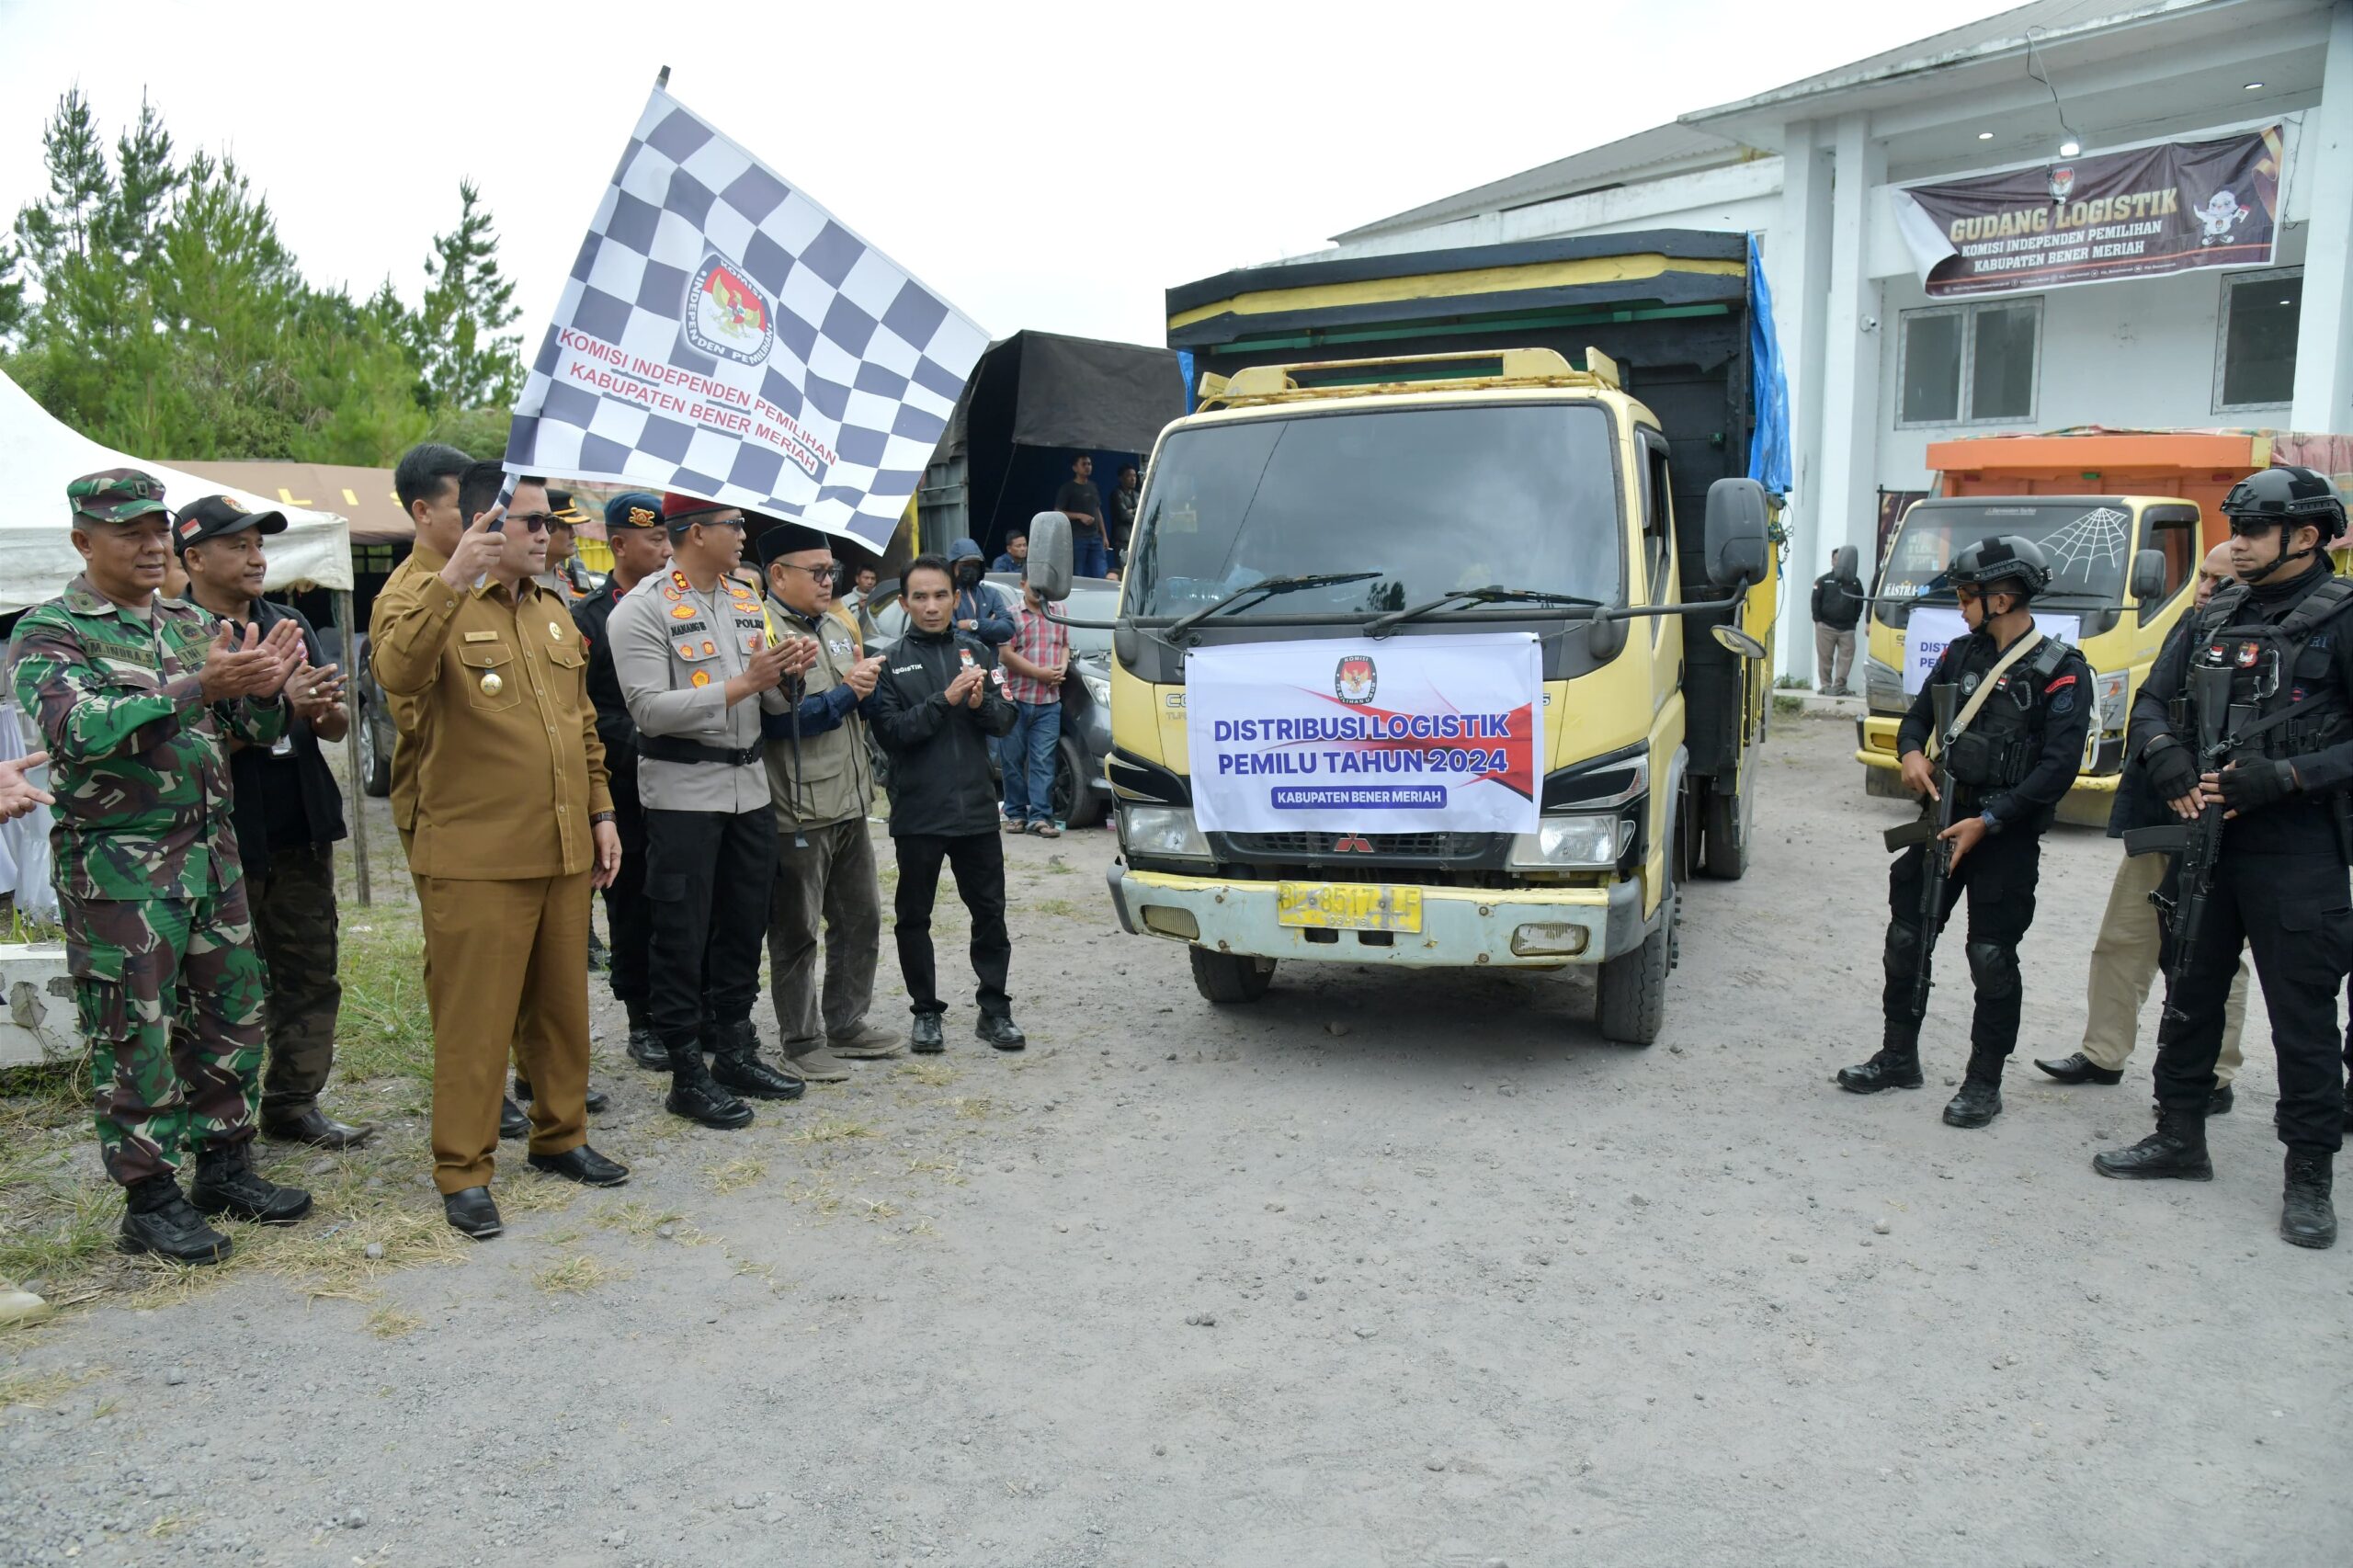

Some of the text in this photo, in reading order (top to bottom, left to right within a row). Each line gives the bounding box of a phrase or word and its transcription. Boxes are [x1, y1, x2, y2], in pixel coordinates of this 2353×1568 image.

[1949, 187, 2177, 243] GUDANG LOGISTIK
[1961, 220, 2162, 257] KOMISI INDEPENDEN PEMILIHAN
[1974, 240, 2144, 273] KABUPATEN BENER MERIAH
[720, 259, 764, 301] KOMISI
[688, 277, 773, 365] INDEPENDEN PEMILIHAN
[560, 328, 836, 466] KOMISI INDEPENDEN PEMILIHAN
[570, 361, 815, 472] KABUPATEN BENER MERIAH
[892, 664, 923, 675] LOGISTIK
[1214, 713, 1510, 742] DISTRIBUSI LOGISTIK
[1219, 749, 1508, 775] PEMILU TAHUN 2024
[1278, 790, 1441, 803] KABUPATEN BENER MERIAH
[1321, 886, 1374, 914] 8517
